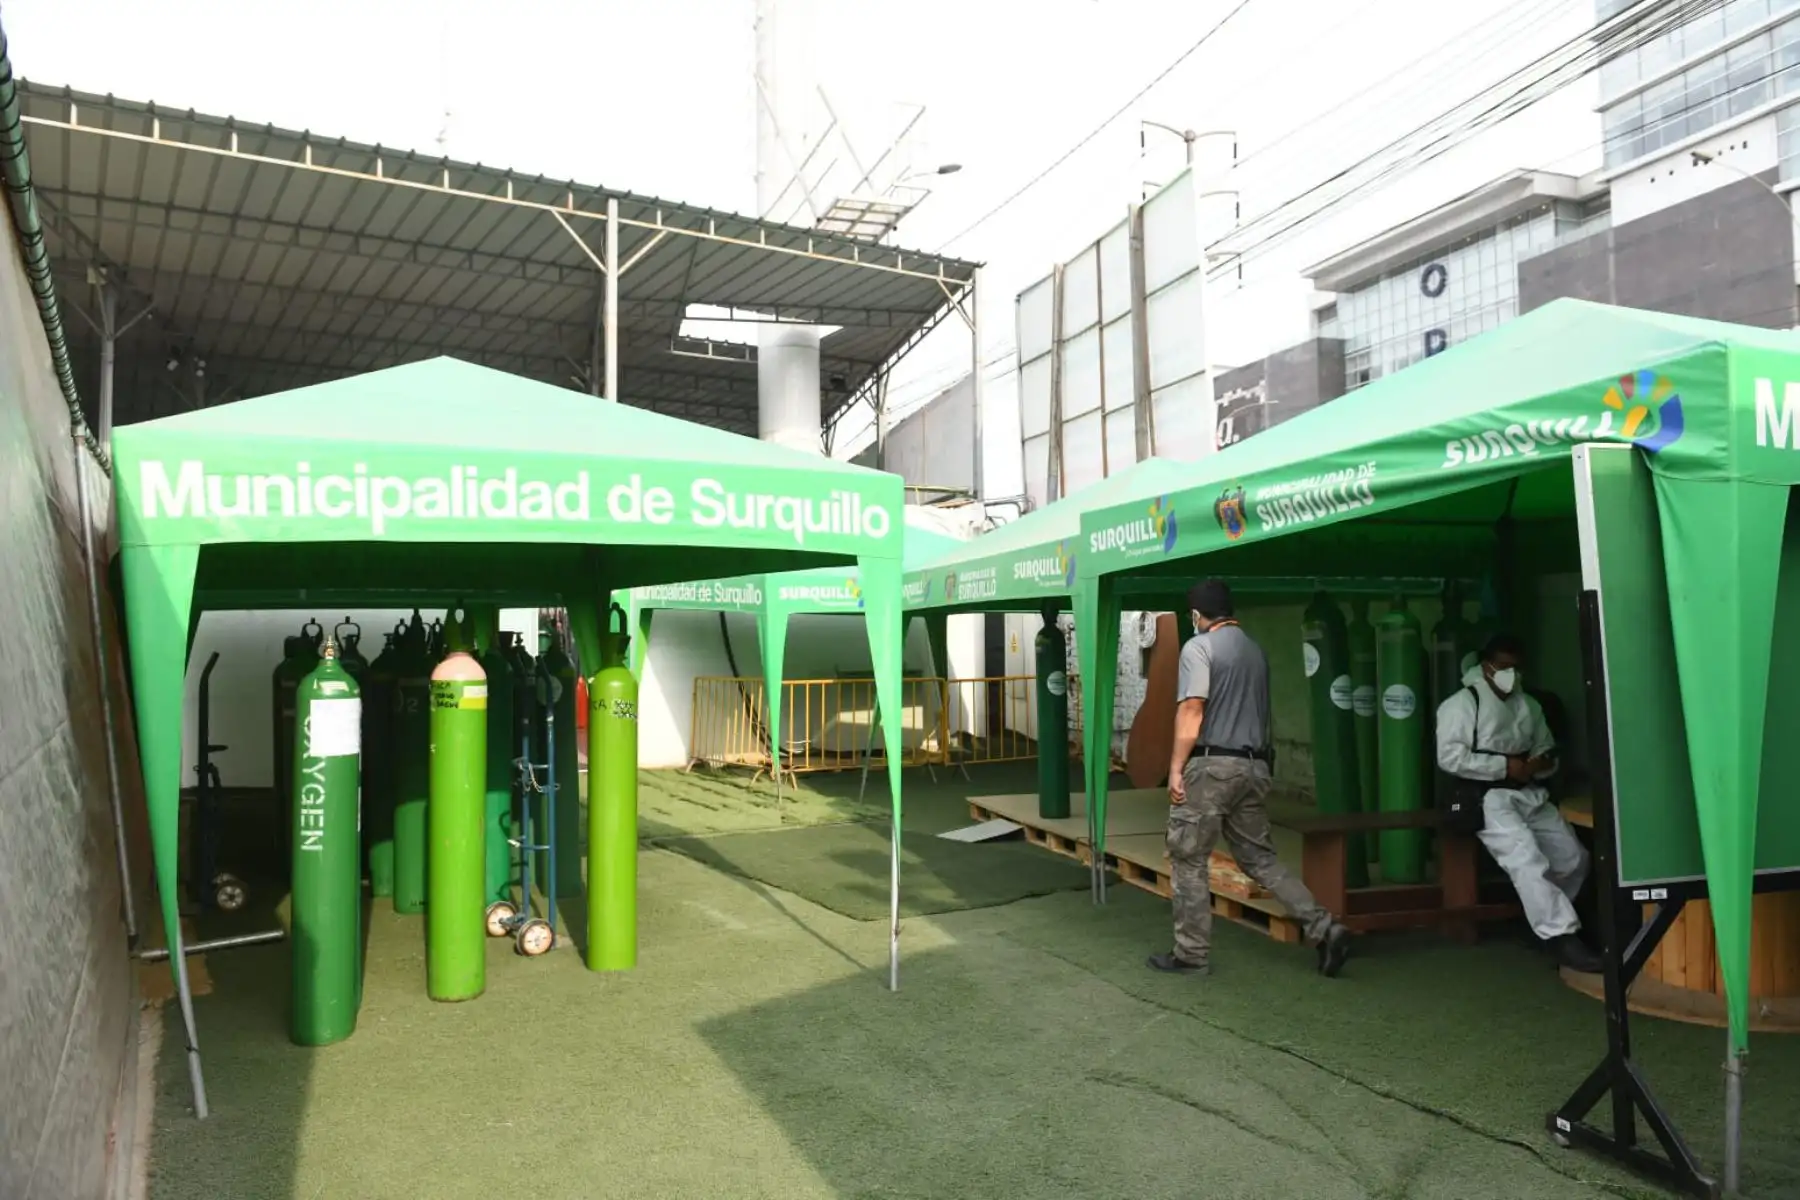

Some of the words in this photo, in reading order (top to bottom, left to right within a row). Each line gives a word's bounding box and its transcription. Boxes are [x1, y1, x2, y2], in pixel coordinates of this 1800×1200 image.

[1357, 460, 1376, 478] DE
[138, 459, 590, 536] Municipalidad
[606, 473, 674, 524] de
[690, 477, 891, 545] Surquillo
[1256, 478, 1375, 531] SURQUILLO
[714, 582, 762, 609] Surquillo
